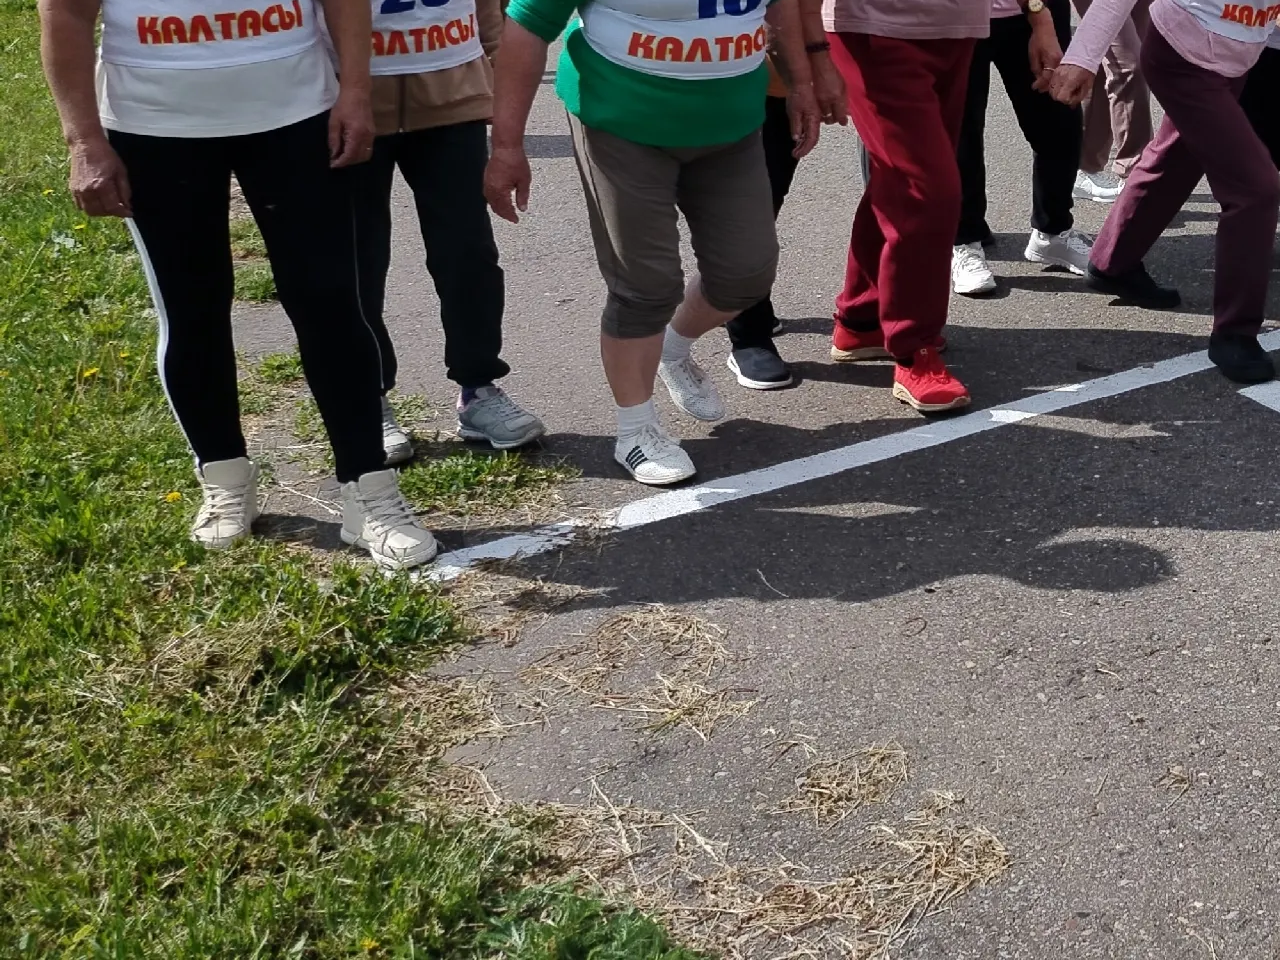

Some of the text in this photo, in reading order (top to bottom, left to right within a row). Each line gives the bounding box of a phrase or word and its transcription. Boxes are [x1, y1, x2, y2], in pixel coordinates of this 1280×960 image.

[136, 0, 303, 44] КАЛТАСЫ
[371, 14, 475, 57] АЛТАСЫ
[627, 25, 766, 62] КАЛТАС
